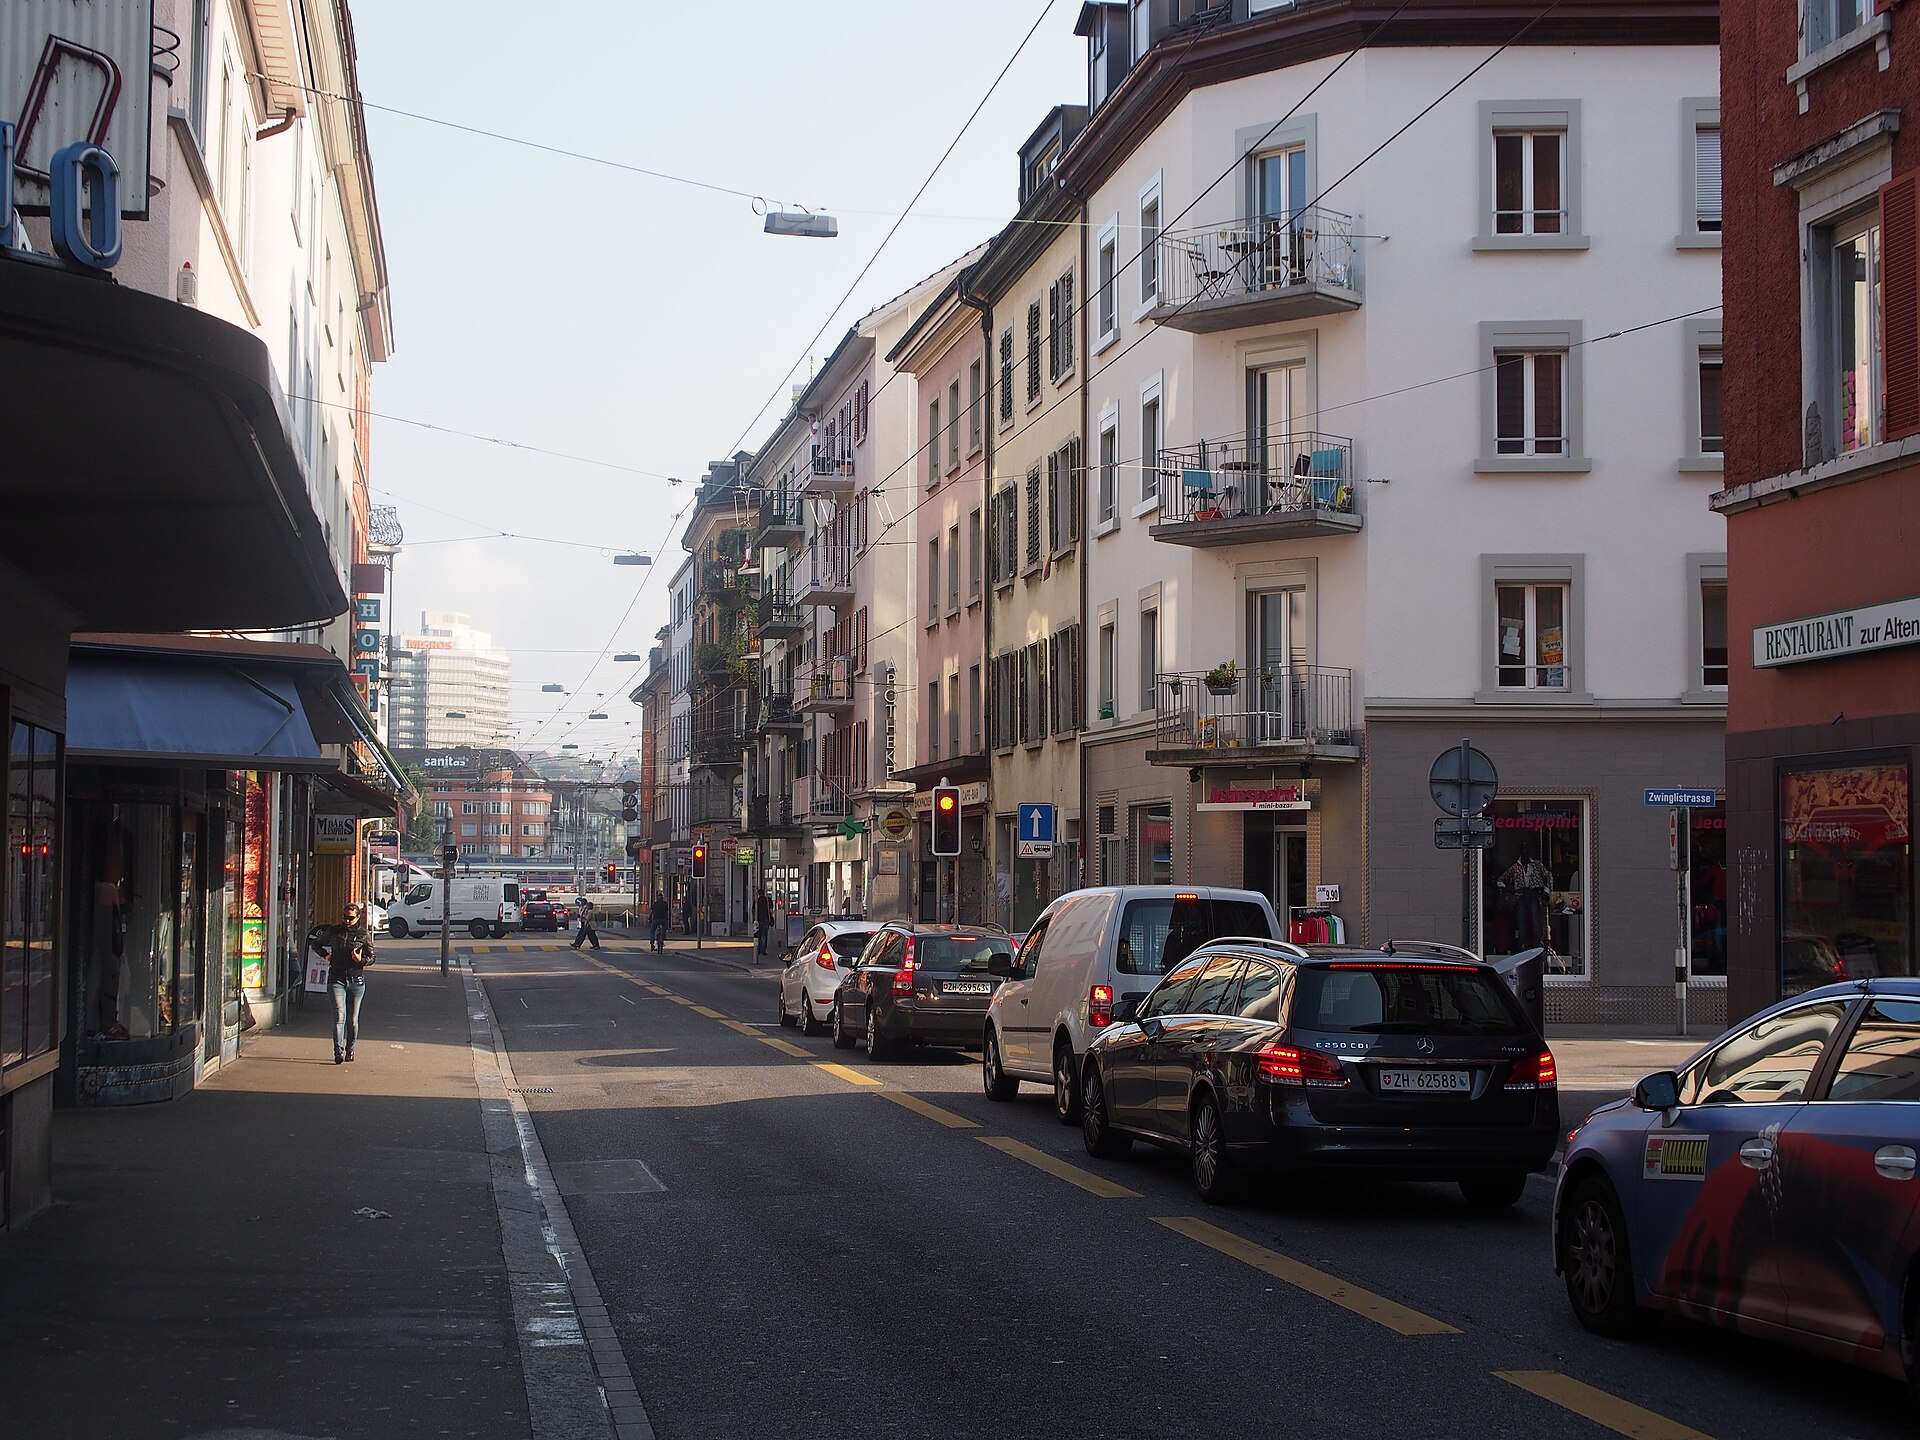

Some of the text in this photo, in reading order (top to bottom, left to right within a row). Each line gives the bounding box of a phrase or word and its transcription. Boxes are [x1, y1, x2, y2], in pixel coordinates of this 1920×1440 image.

[407, 639, 453, 649] MIGROS
[1766, 616, 1920, 660] RESTAURANT zur Alten
[884, 656, 898, 780] APOTHEKE
[424, 757, 466, 767] sanitas
[1206, 785, 1298, 807] Jeanspoint
[1648, 792, 1711, 804] Zwinglistrasse
[1492, 815, 1579, 831] eanspoint
[1326, 890, 1338, 900] 9.90
[1393, 1073, 1457, 1089] ZH 62588
